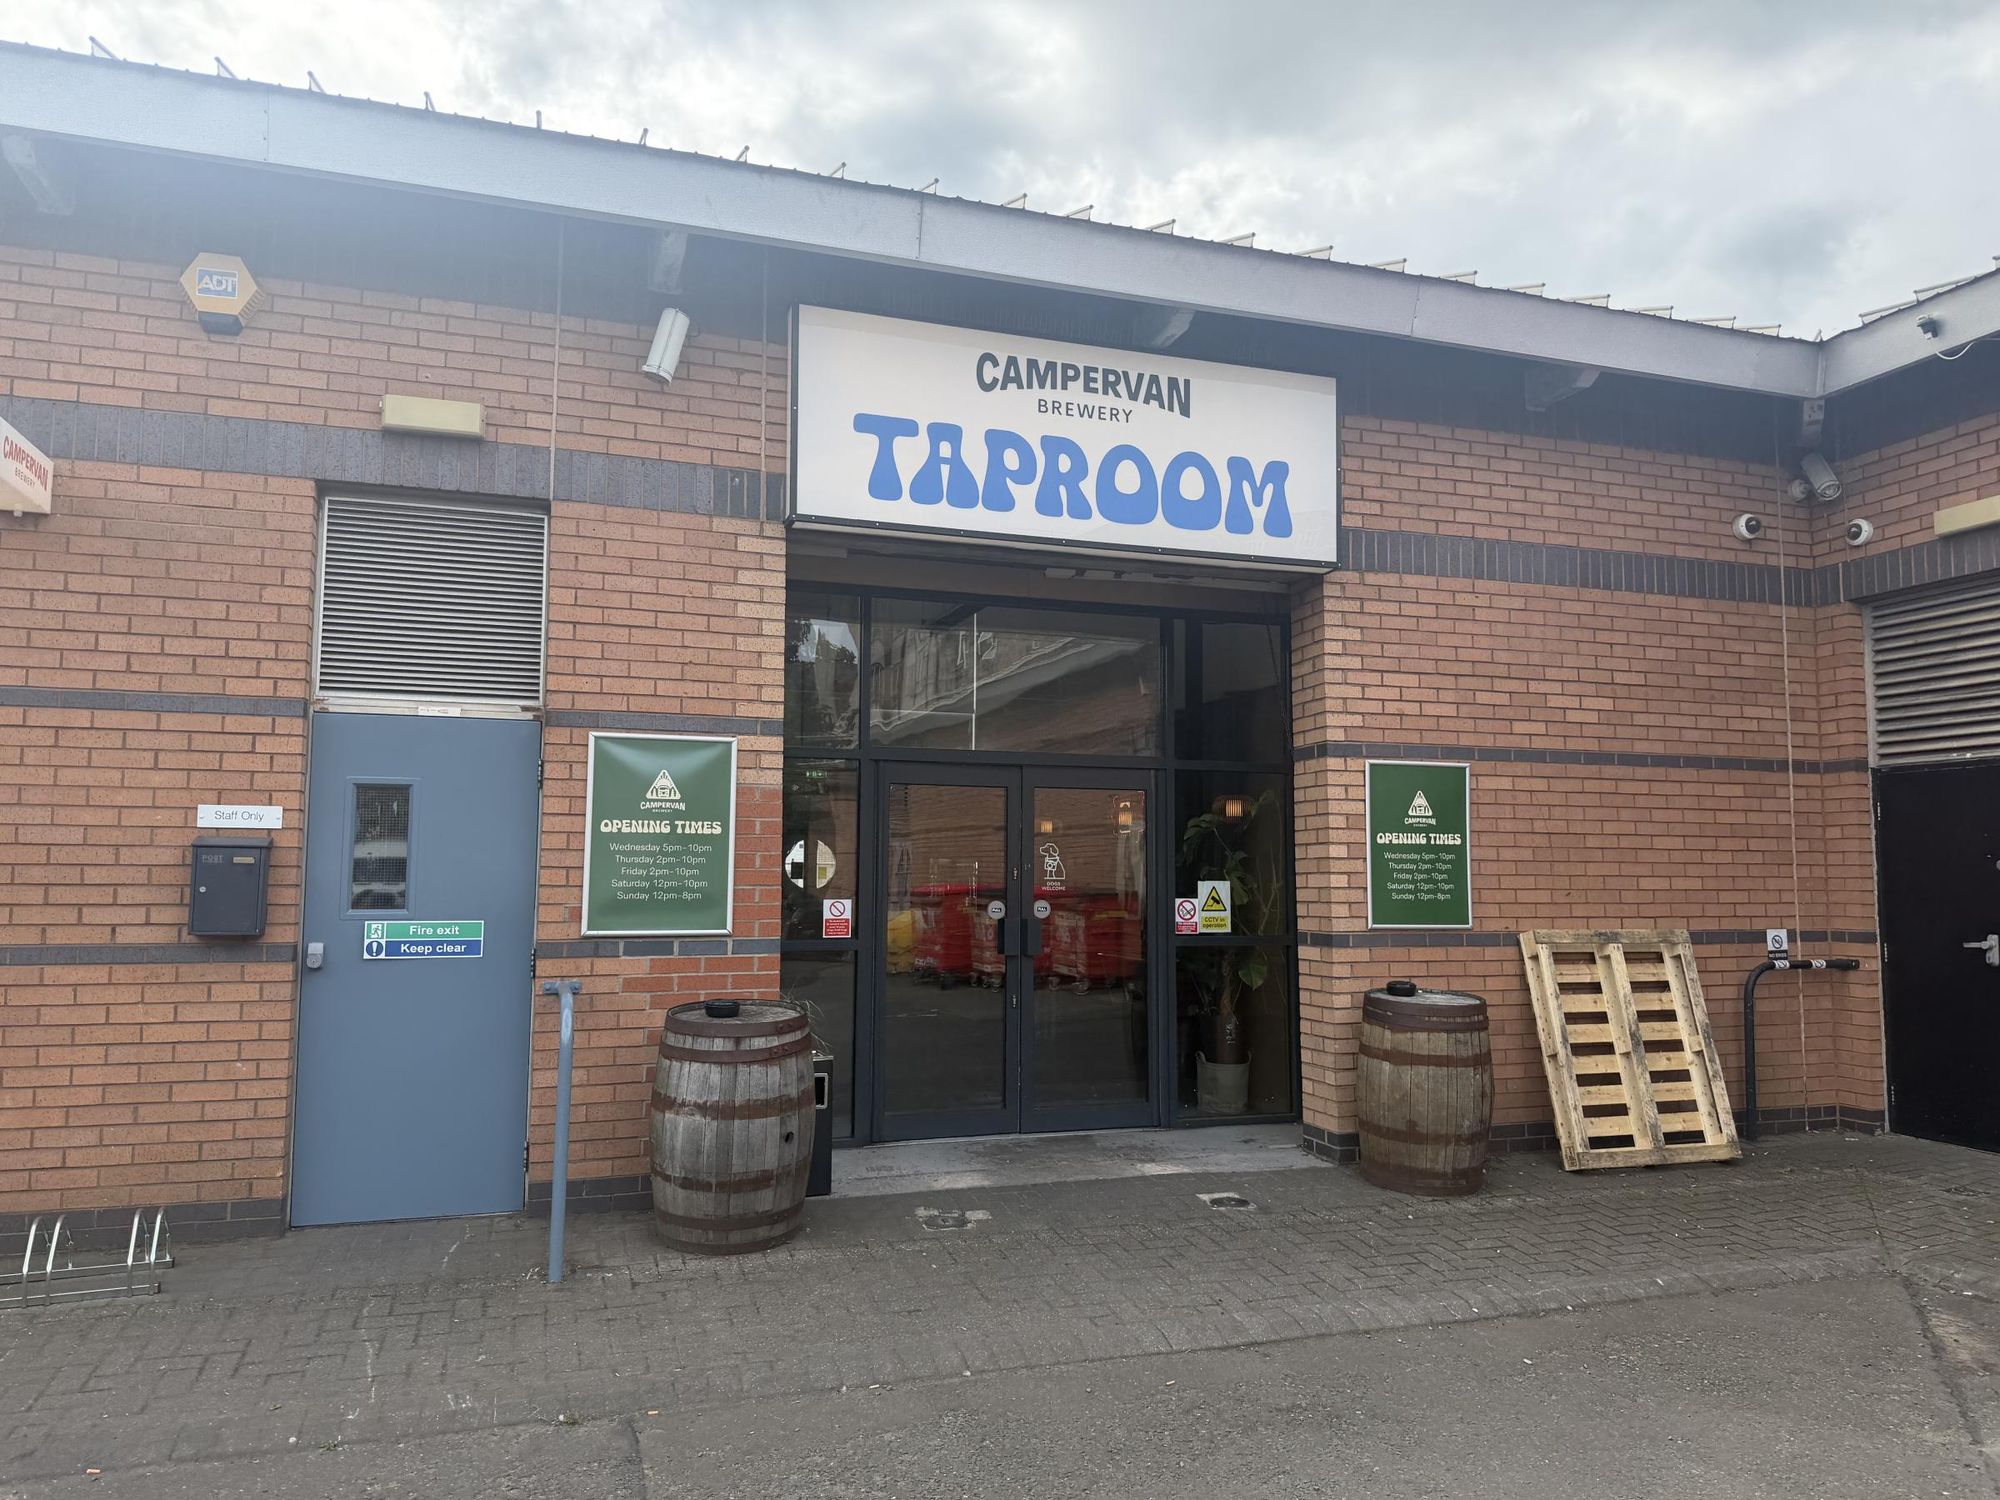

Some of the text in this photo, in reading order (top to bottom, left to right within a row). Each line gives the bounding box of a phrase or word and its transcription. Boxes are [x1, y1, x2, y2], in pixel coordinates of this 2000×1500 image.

[198, 274, 237, 293] ADT
[975, 351, 1192, 420] CAMPERVAN
[1037, 397, 1133, 424] BREWERY
[3, 434, 49, 492] CAMPERVAN
[852, 412, 1294, 539] TAPROOM
[640, 801, 686, 811] CAMPERVAN
[214, 810, 265, 823] Staff Only
[600, 819, 723, 835] OPENING TIMES
[1376, 832, 1462, 845] OPENING TIMES
[609, 842, 661, 853] Wednesday
[202, 854, 224, 864] POST
[615, 854, 655, 865] Thursday
[1383, 851, 1421, 861] Wednesday
[621, 866, 648, 877] Friday
[1389, 862, 1417, 871] Thursday
[1393, 872, 1413, 881] Friday
[611, 879, 650, 889] Saturday
[1387, 882, 1416, 891] Saturday
[617, 890, 650, 901] Sunday
[1391, 892, 1416, 901] Sunday
[409, 924, 460, 936] Fire exit
[1202, 922, 1227, 930] operation
[400, 943, 467, 956] Keep clear
